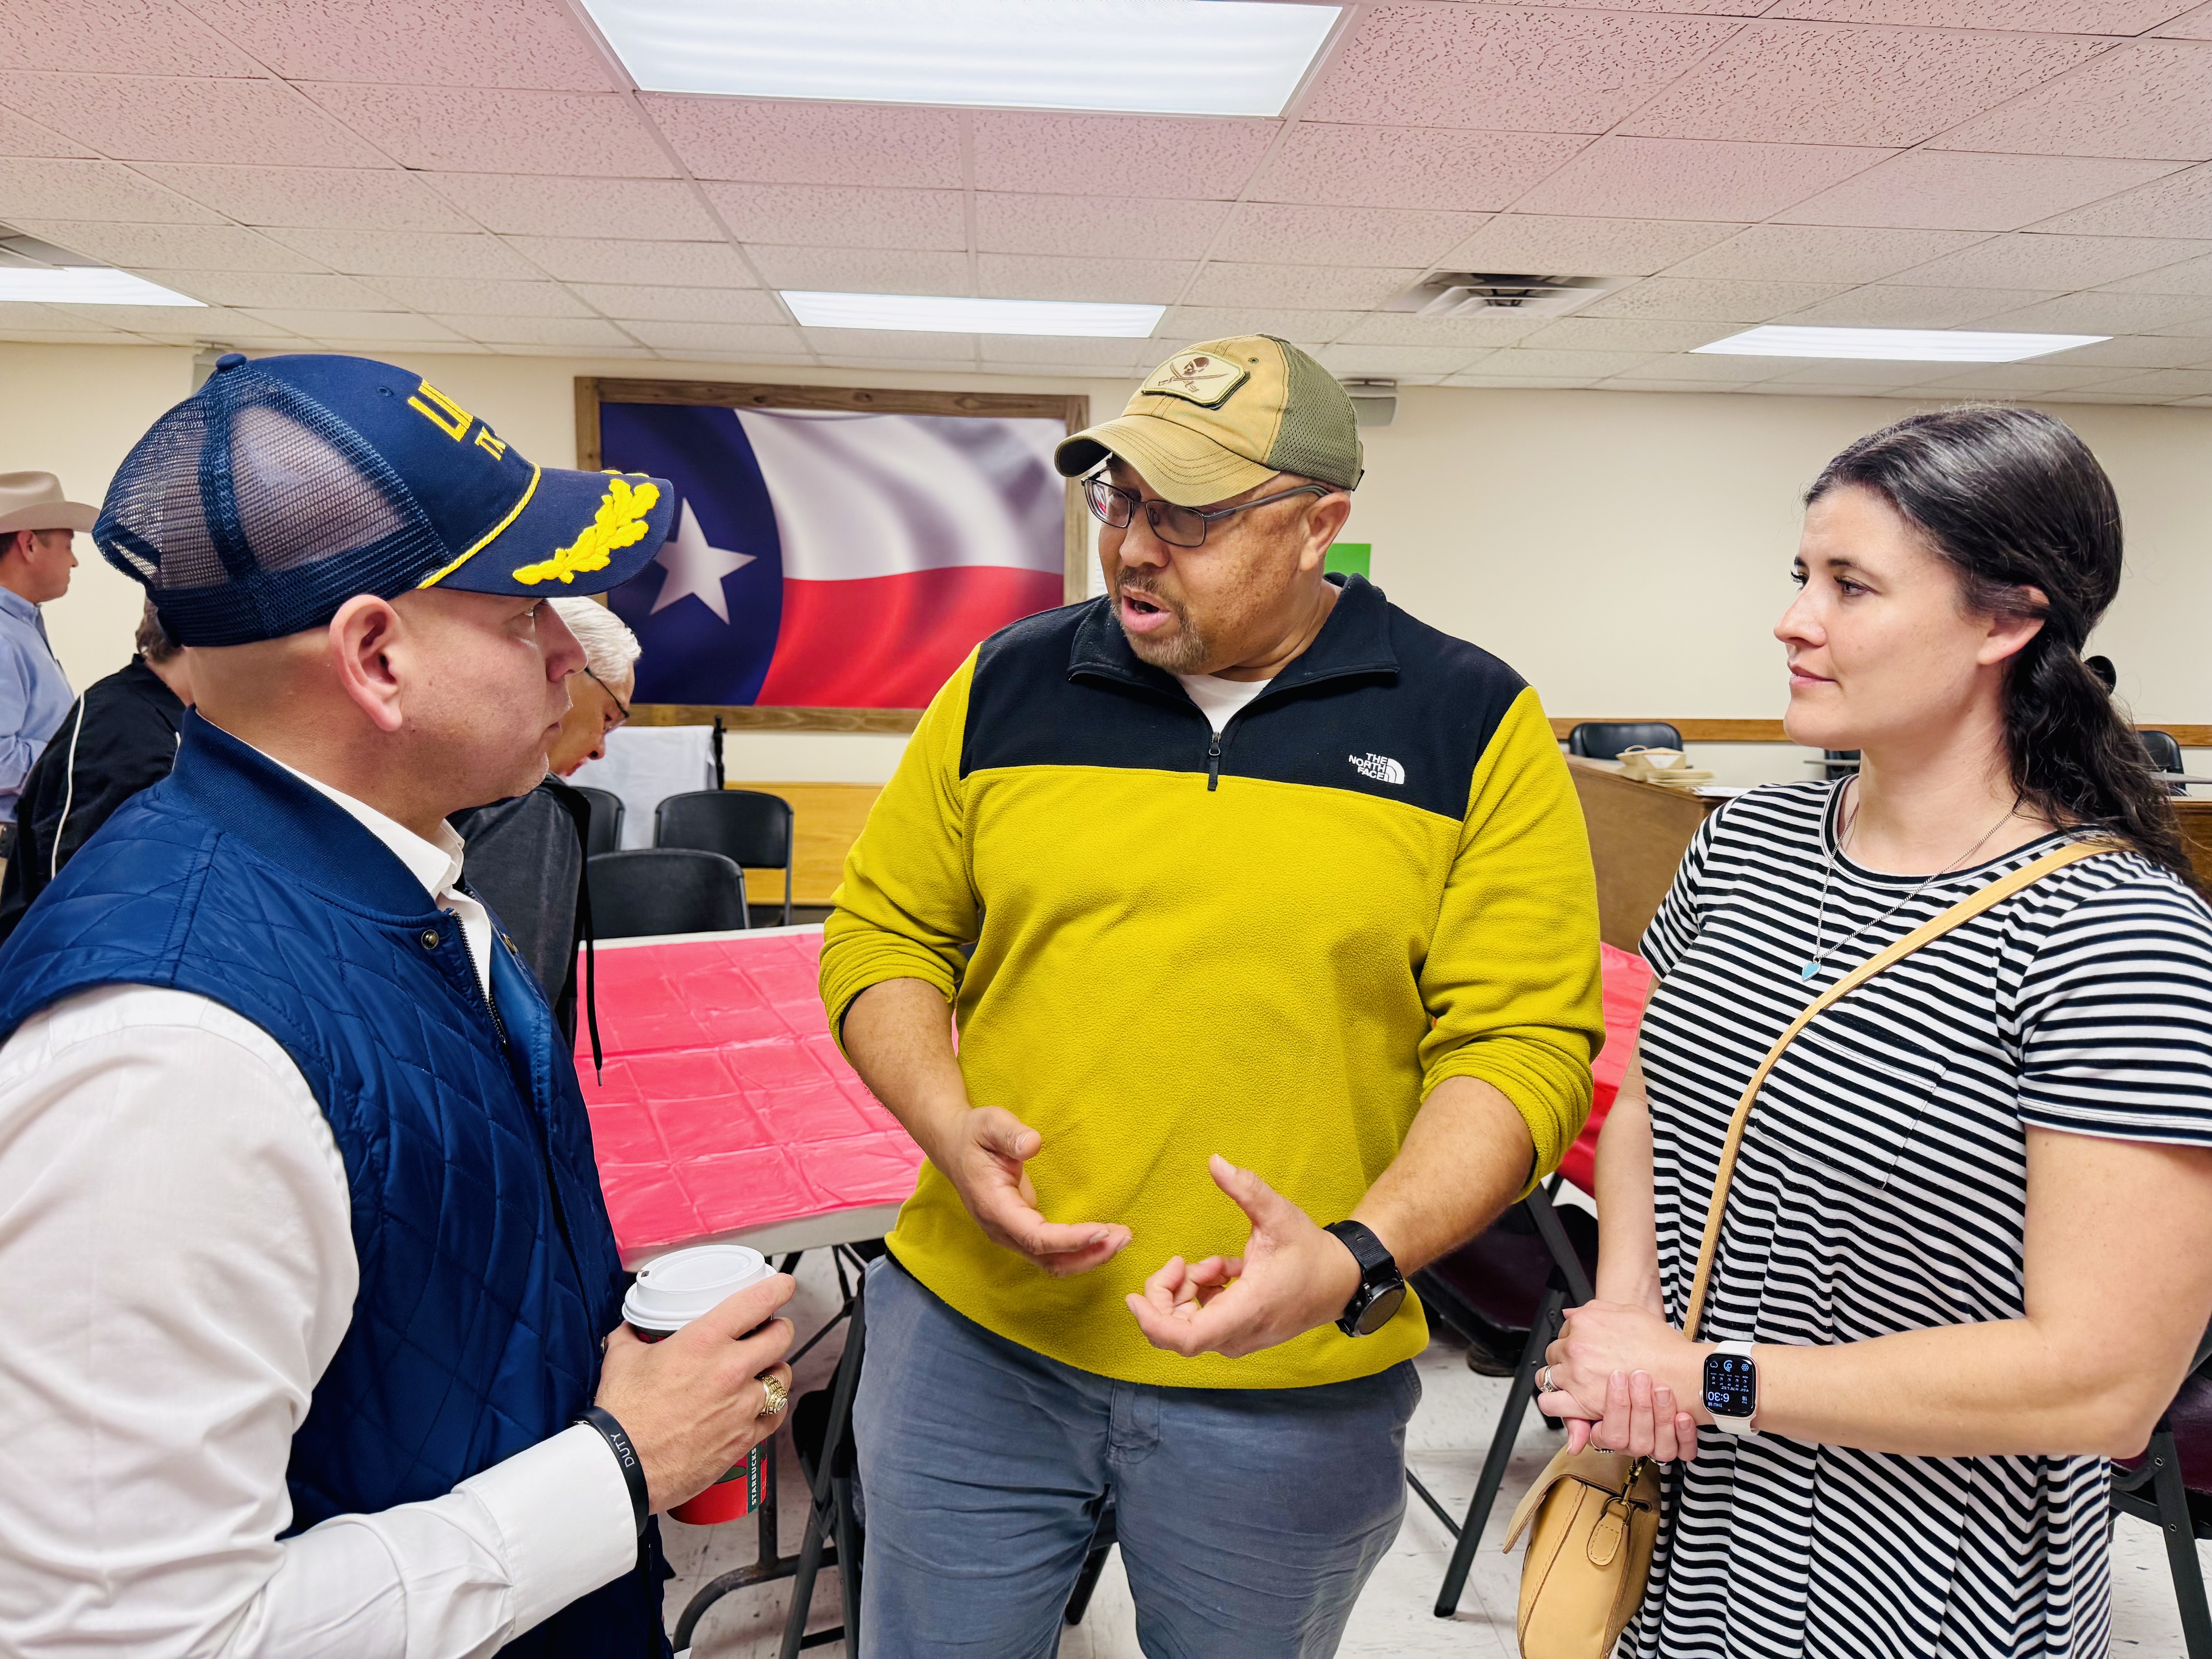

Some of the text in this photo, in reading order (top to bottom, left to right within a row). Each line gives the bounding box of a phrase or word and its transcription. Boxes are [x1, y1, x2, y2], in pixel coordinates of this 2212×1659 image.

[1348, 754, 1386, 773] NORTH
[1365, 752, 1388, 765] THE
[1357, 766, 1384, 781] FACE
[1708, 1391, 1729, 1402] 6:30
[610, 1433, 635, 1467] DUTY
